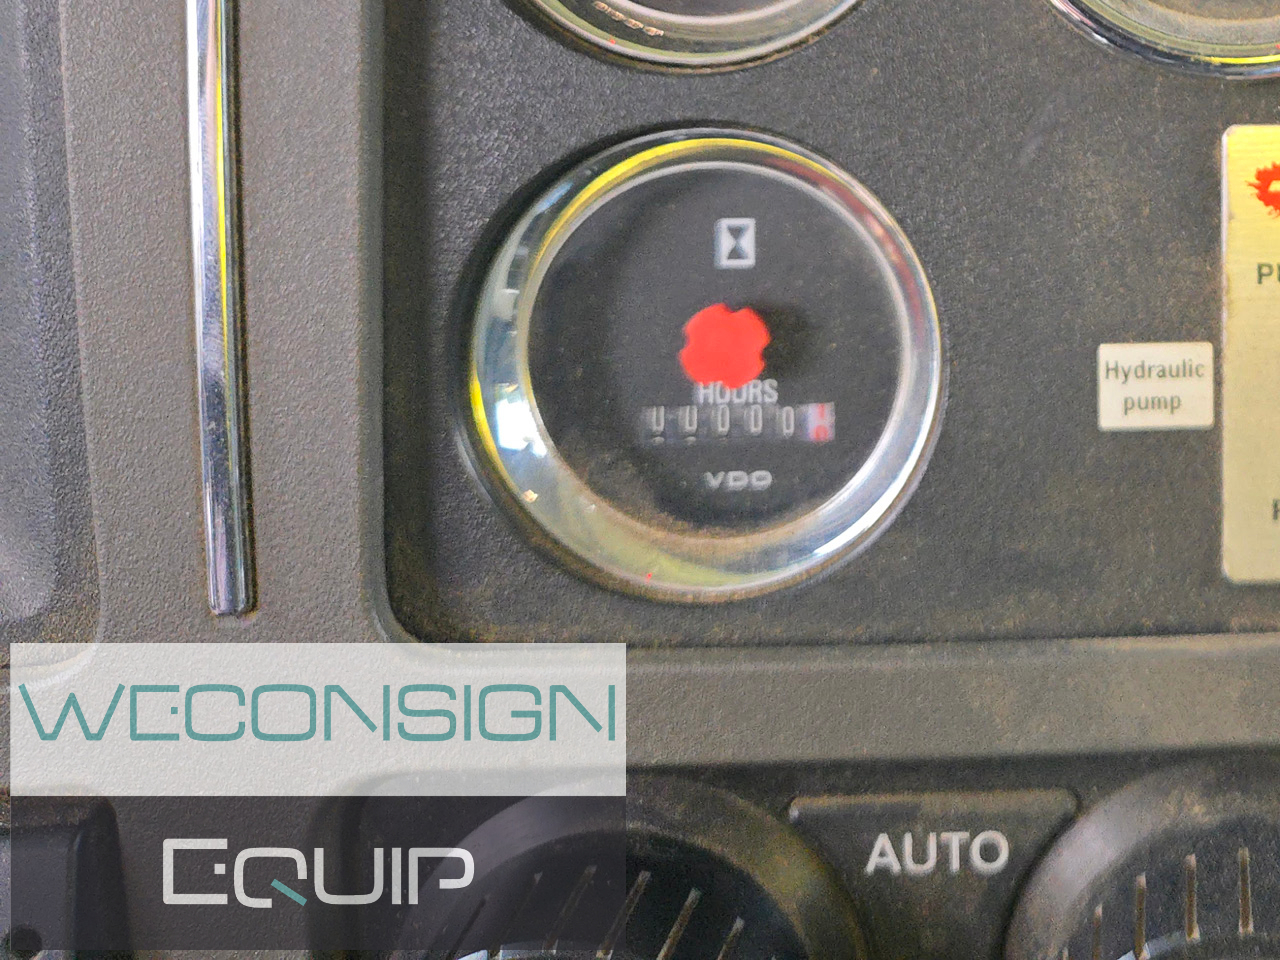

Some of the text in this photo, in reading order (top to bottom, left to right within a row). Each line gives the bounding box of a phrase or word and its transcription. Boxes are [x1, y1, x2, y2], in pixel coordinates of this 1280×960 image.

[1105, 358, 1206, 385] Hydraulic
[697, 379, 778, 404] HOURS
[1123, 396, 1182, 413] pump
[704, 470, 773, 490] VDO
[864, 830, 1010, 875] AUTO
